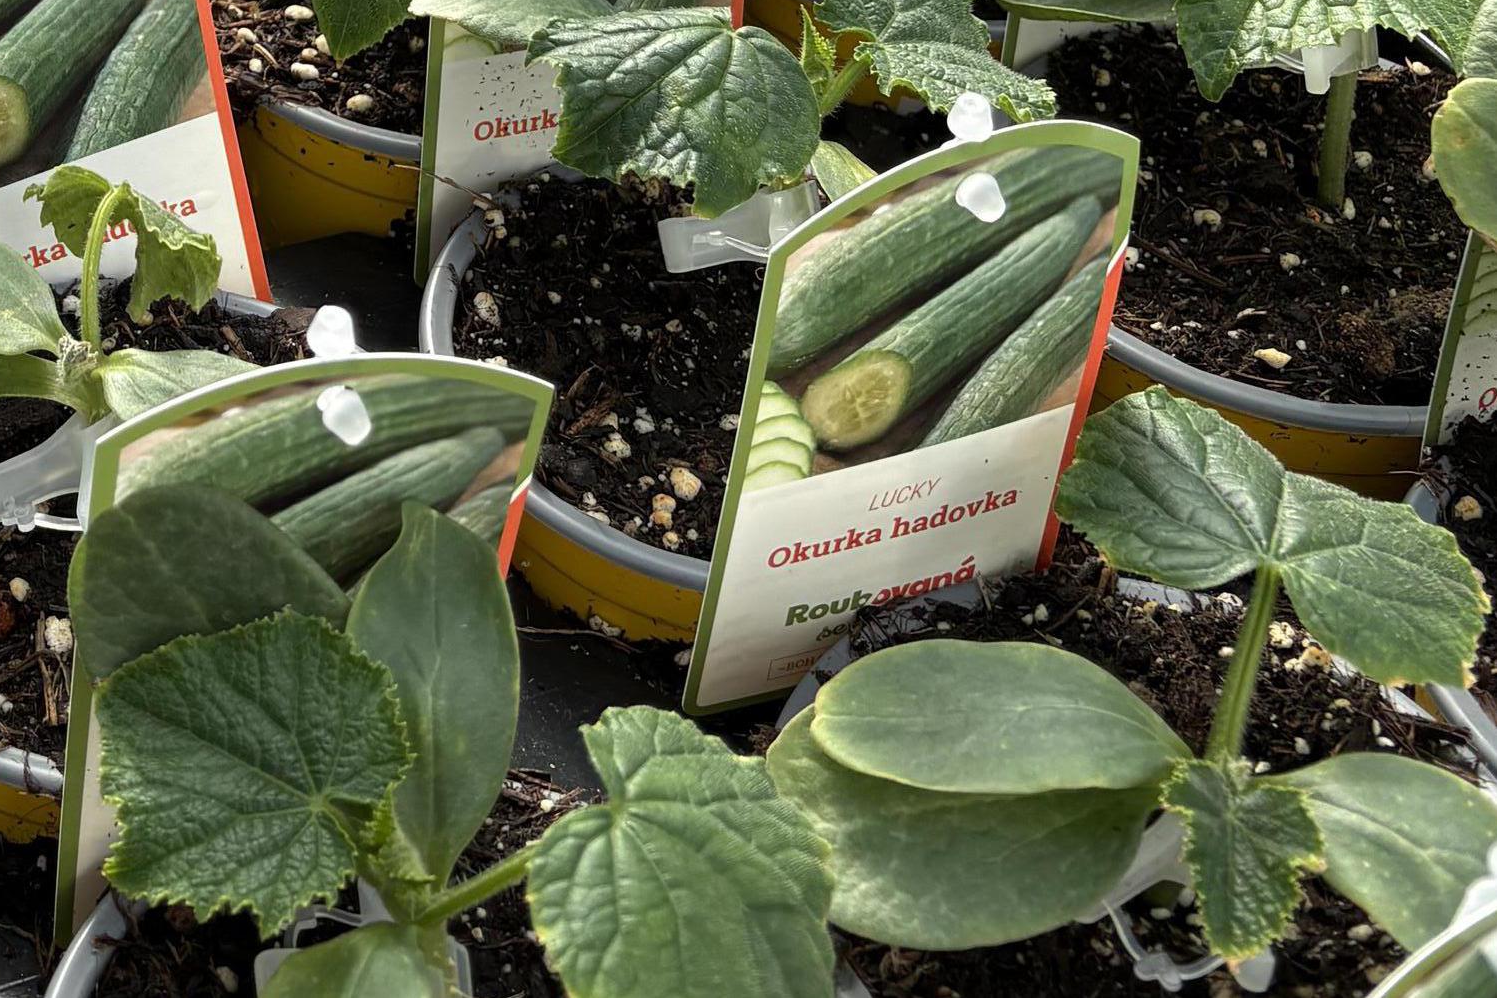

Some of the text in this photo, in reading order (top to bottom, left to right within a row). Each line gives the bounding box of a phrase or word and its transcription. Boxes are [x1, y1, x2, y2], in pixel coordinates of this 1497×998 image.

[473, 108, 559, 141] Okurk
[868, 477, 942, 512] LUCKY
[767, 488, 1018, 569] Okurka hadovka
